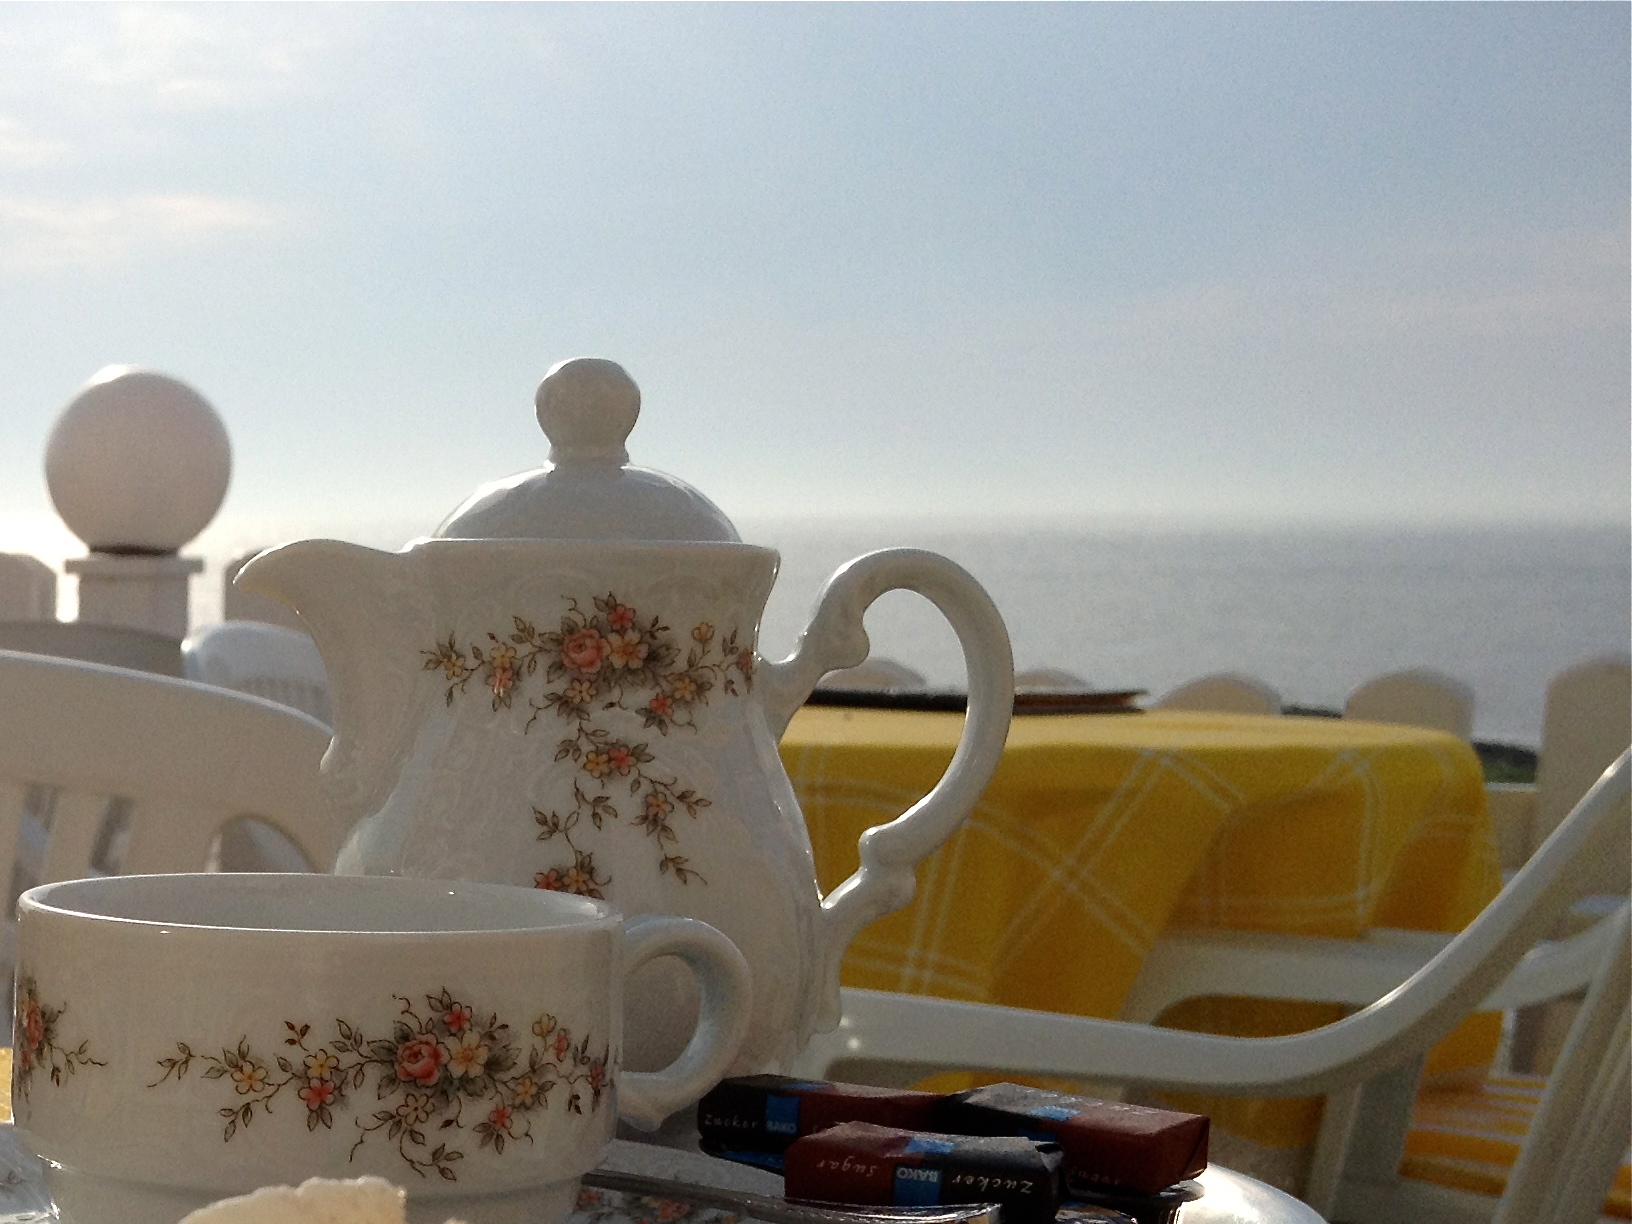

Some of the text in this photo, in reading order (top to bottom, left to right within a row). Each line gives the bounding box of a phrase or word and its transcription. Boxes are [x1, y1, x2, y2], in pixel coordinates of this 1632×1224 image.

[704, 1114, 759, 1129] Zucker
[766, 1120, 797, 1133] BAKO
[897, 1167, 939, 1182] BAKO
[951, 1173, 1033, 1194] Zucker
